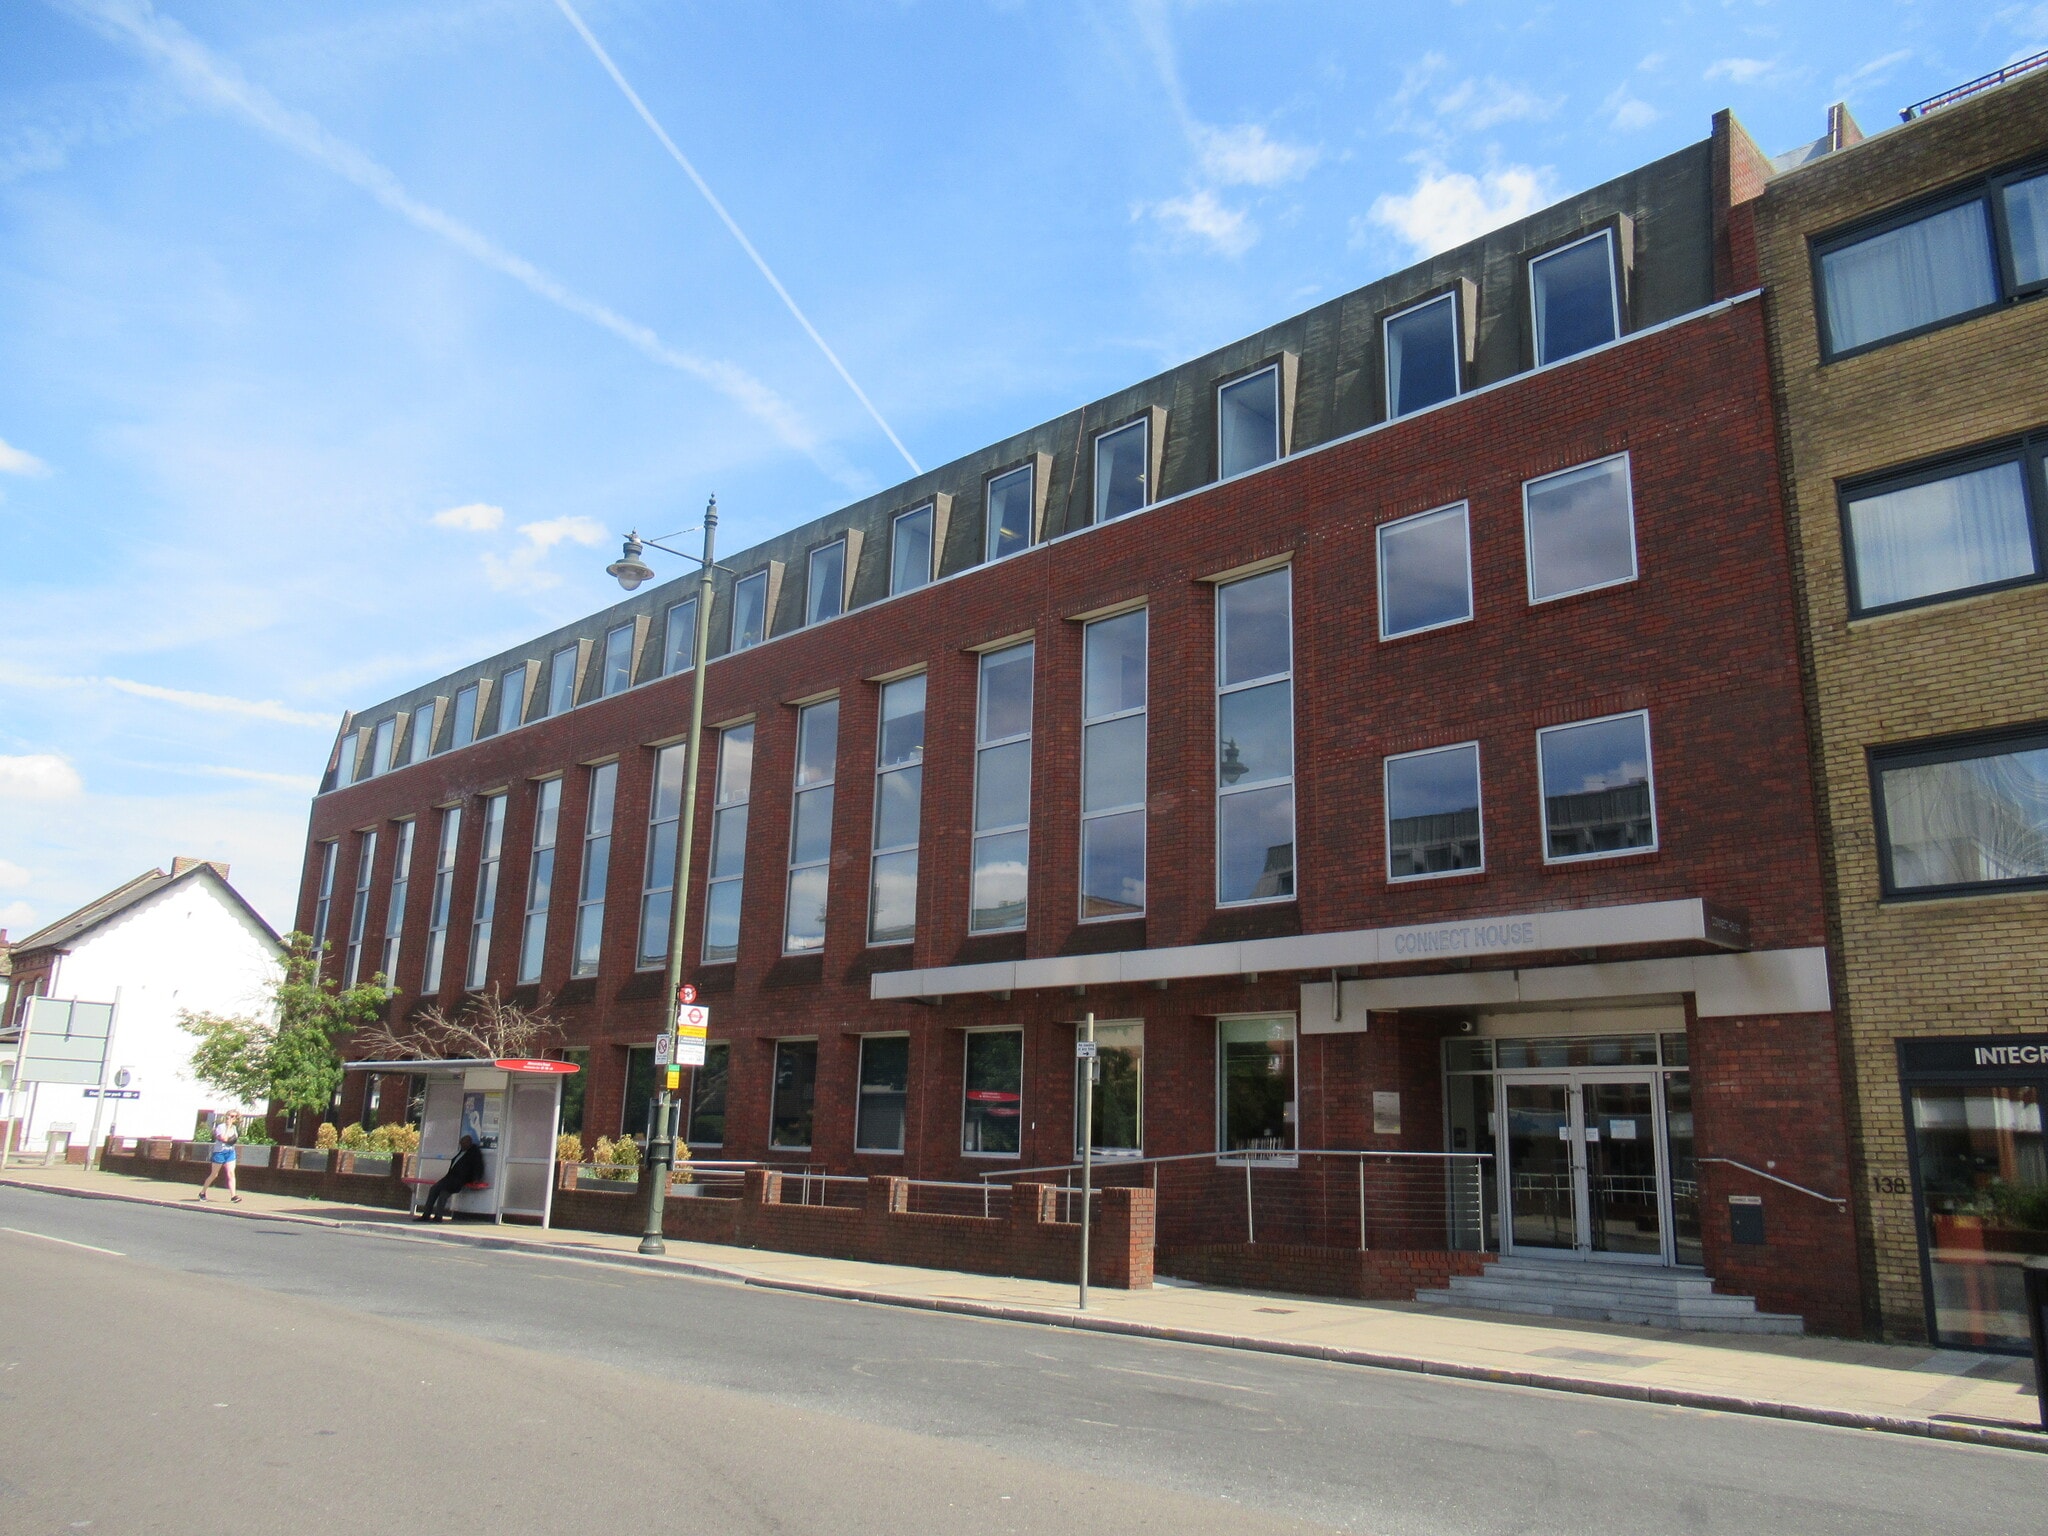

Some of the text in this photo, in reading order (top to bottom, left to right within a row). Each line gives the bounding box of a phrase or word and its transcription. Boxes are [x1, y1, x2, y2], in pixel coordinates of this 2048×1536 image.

[1394, 922, 1534, 955] CONNECT HOUSE
[1873, 1176, 1906, 1194] 138
